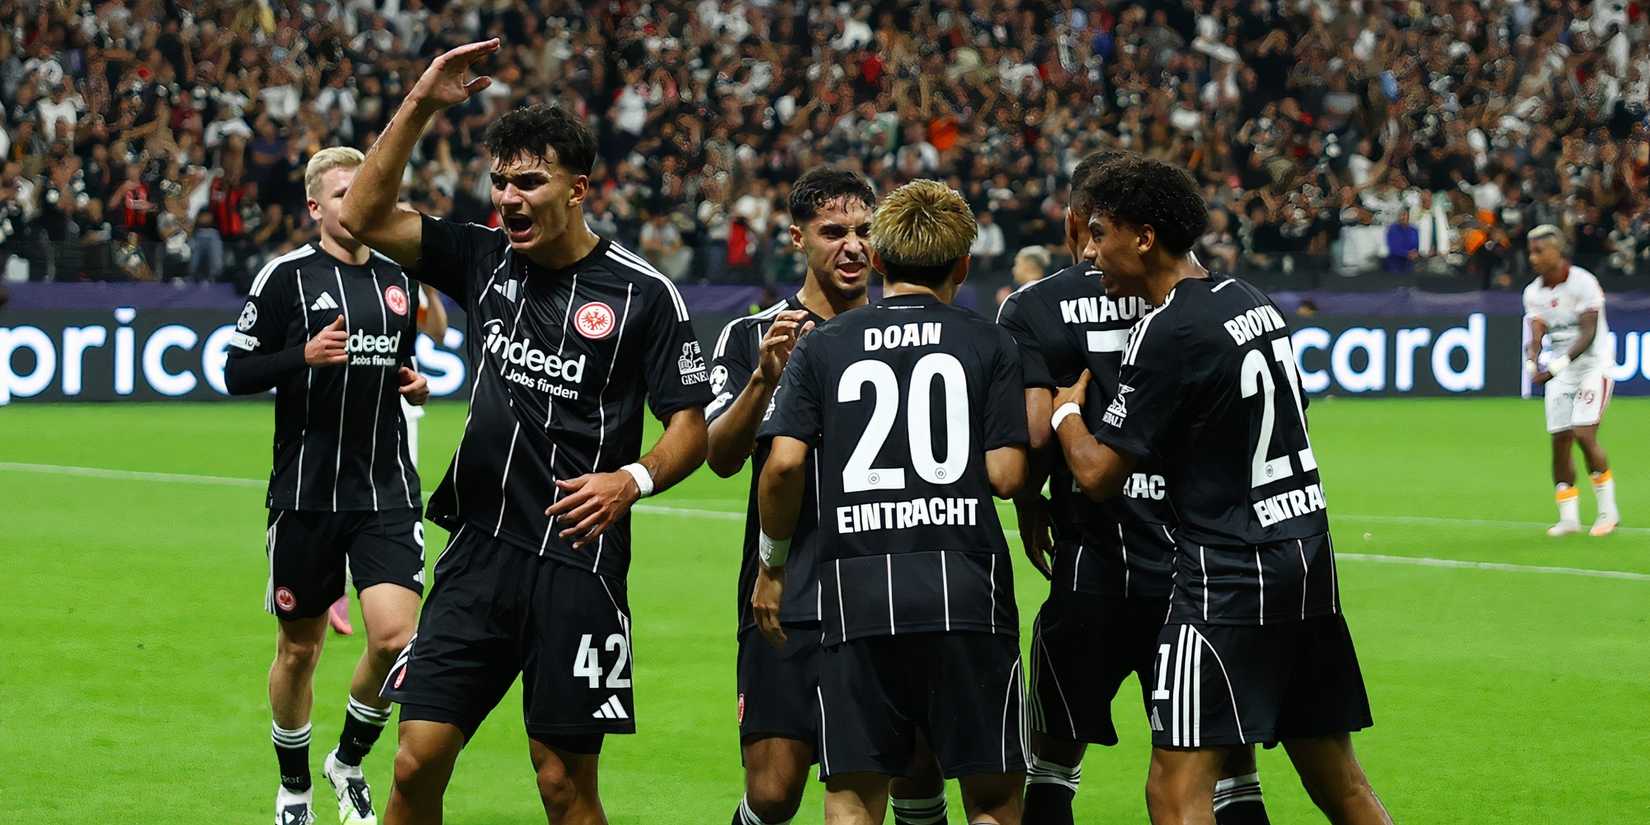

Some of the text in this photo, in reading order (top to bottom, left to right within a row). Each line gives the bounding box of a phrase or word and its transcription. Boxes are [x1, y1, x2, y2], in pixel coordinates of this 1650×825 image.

[485, 320, 586, 383] indeed
[864, 322, 942, 351] DOAN
[350, 354, 371, 366] Jobs
[505, 368, 579, 400] Jobs finden
[838, 352, 970, 493] 20
[1240, 336, 1318, 489] 21
[836, 497, 979, 534] EINTRACHT
[572, 633, 631, 689] 42
